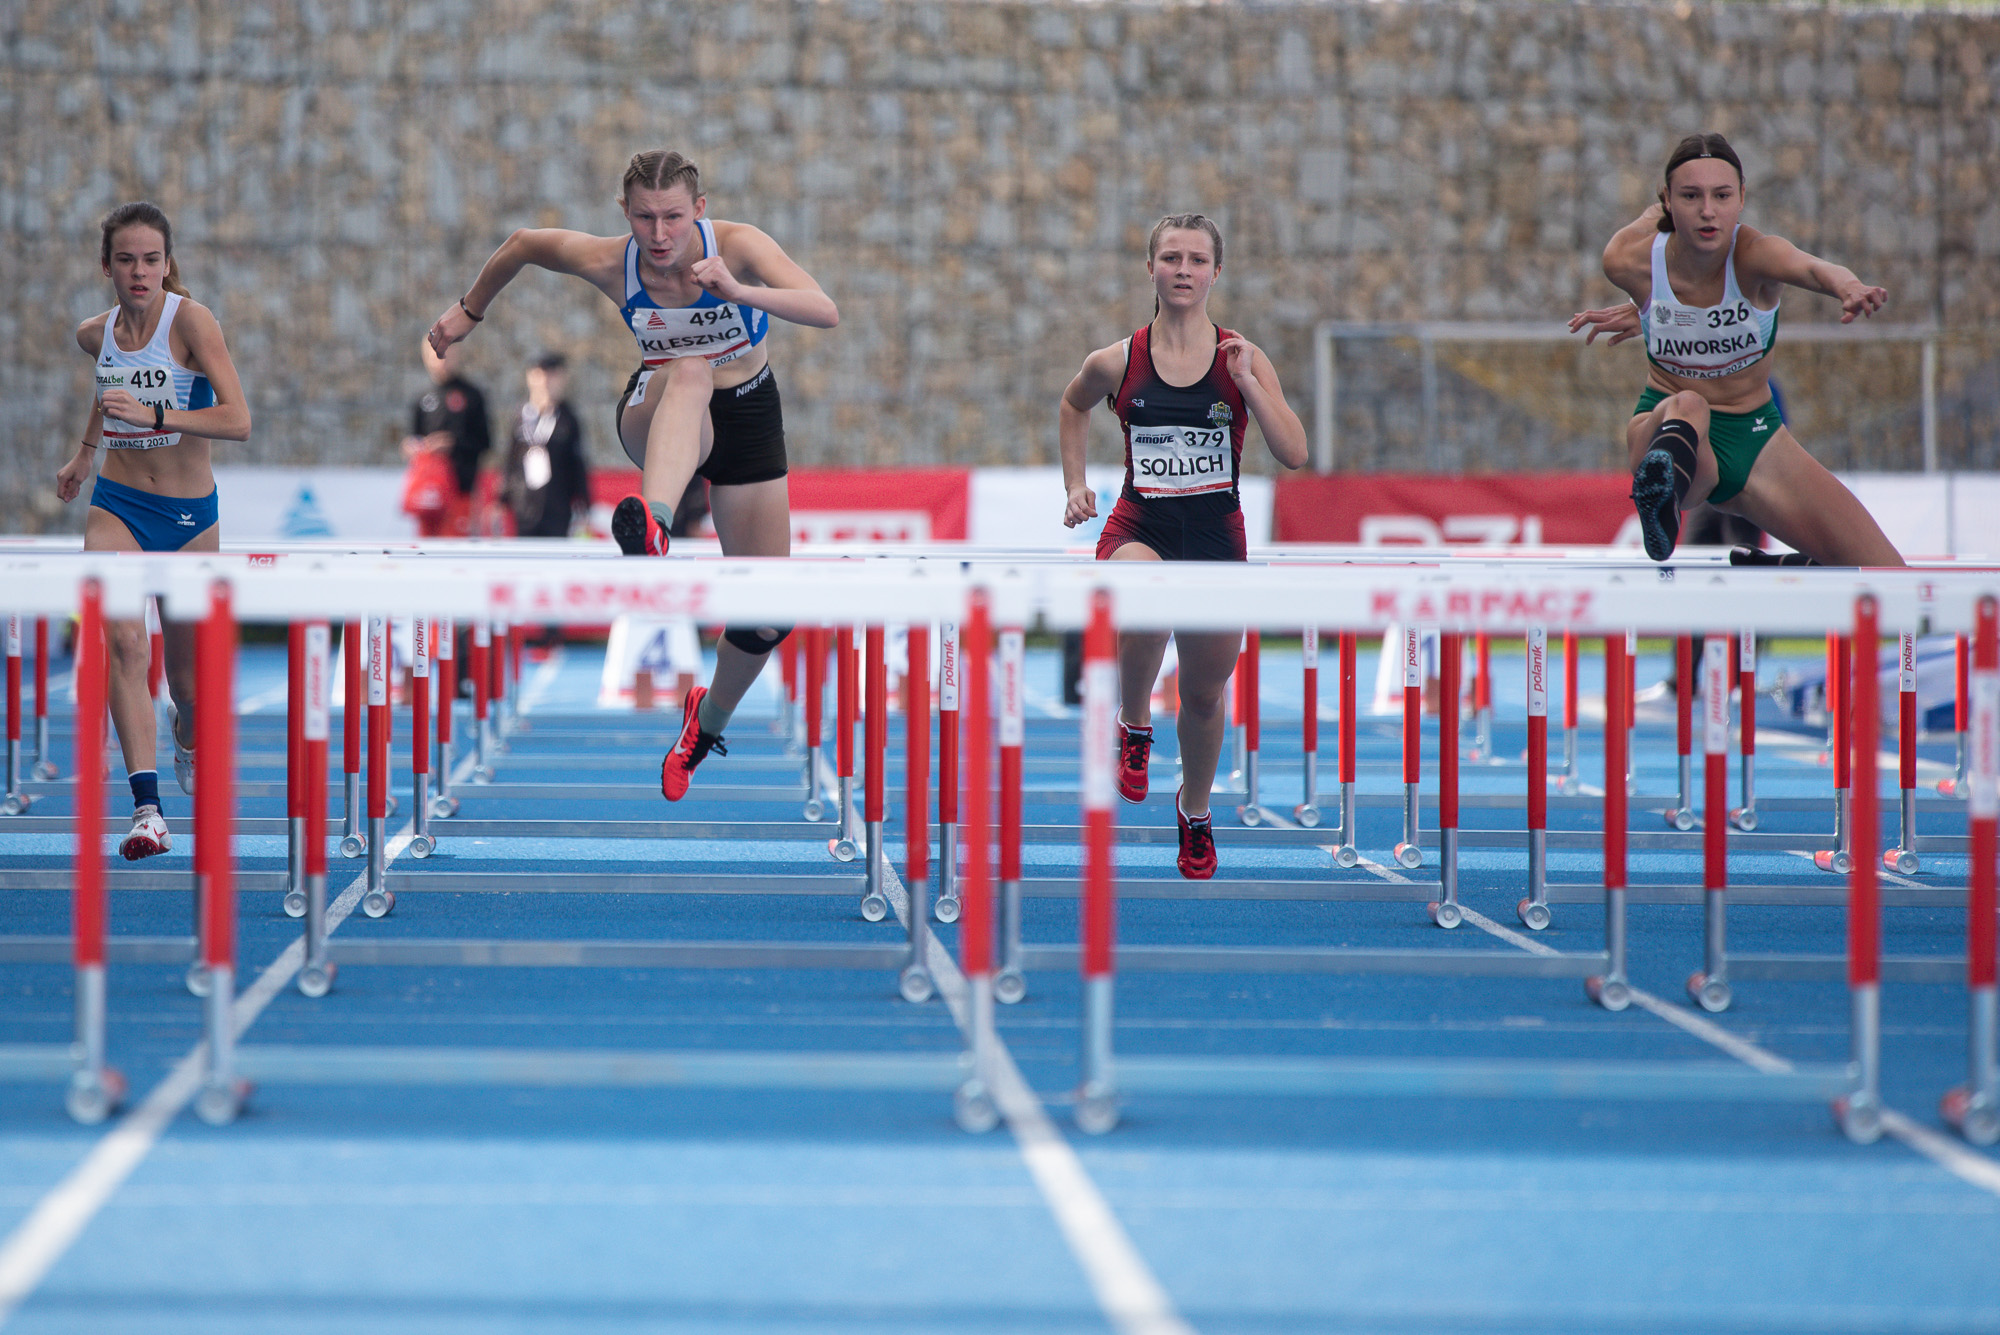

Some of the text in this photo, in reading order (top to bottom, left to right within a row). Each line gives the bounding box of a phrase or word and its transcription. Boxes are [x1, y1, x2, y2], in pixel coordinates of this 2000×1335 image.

[689, 305, 734, 327] 494
[1707, 302, 1750, 329] 326
[641, 326, 742, 352] KLESZNO
[1655, 332, 1758, 356] JAWORSKA
[714, 353, 737, 367] 2021
[1671, 359, 1748, 379] KARPACZ 2021
[130, 369, 167, 389] 419
[736, 365, 770, 397] NIKE PRO
[109, 436, 169, 449] KARPACZ 2021
[1184, 431, 1225, 447] 379
[1140, 453, 1224, 476] SOLLICH
[1371, 589, 1593, 621] KARPACZ
[415, 617, 426, 657] polanik
[1407, 627, 1418, 667] polanik
[371, 634, 383, 682] polanik
[640, 628, 671, 674] 4
[943, 639, 956, 687] polanik
[1903, 631, 1914, 672] polanik
[1531, 644, 1544, 693] polanik
